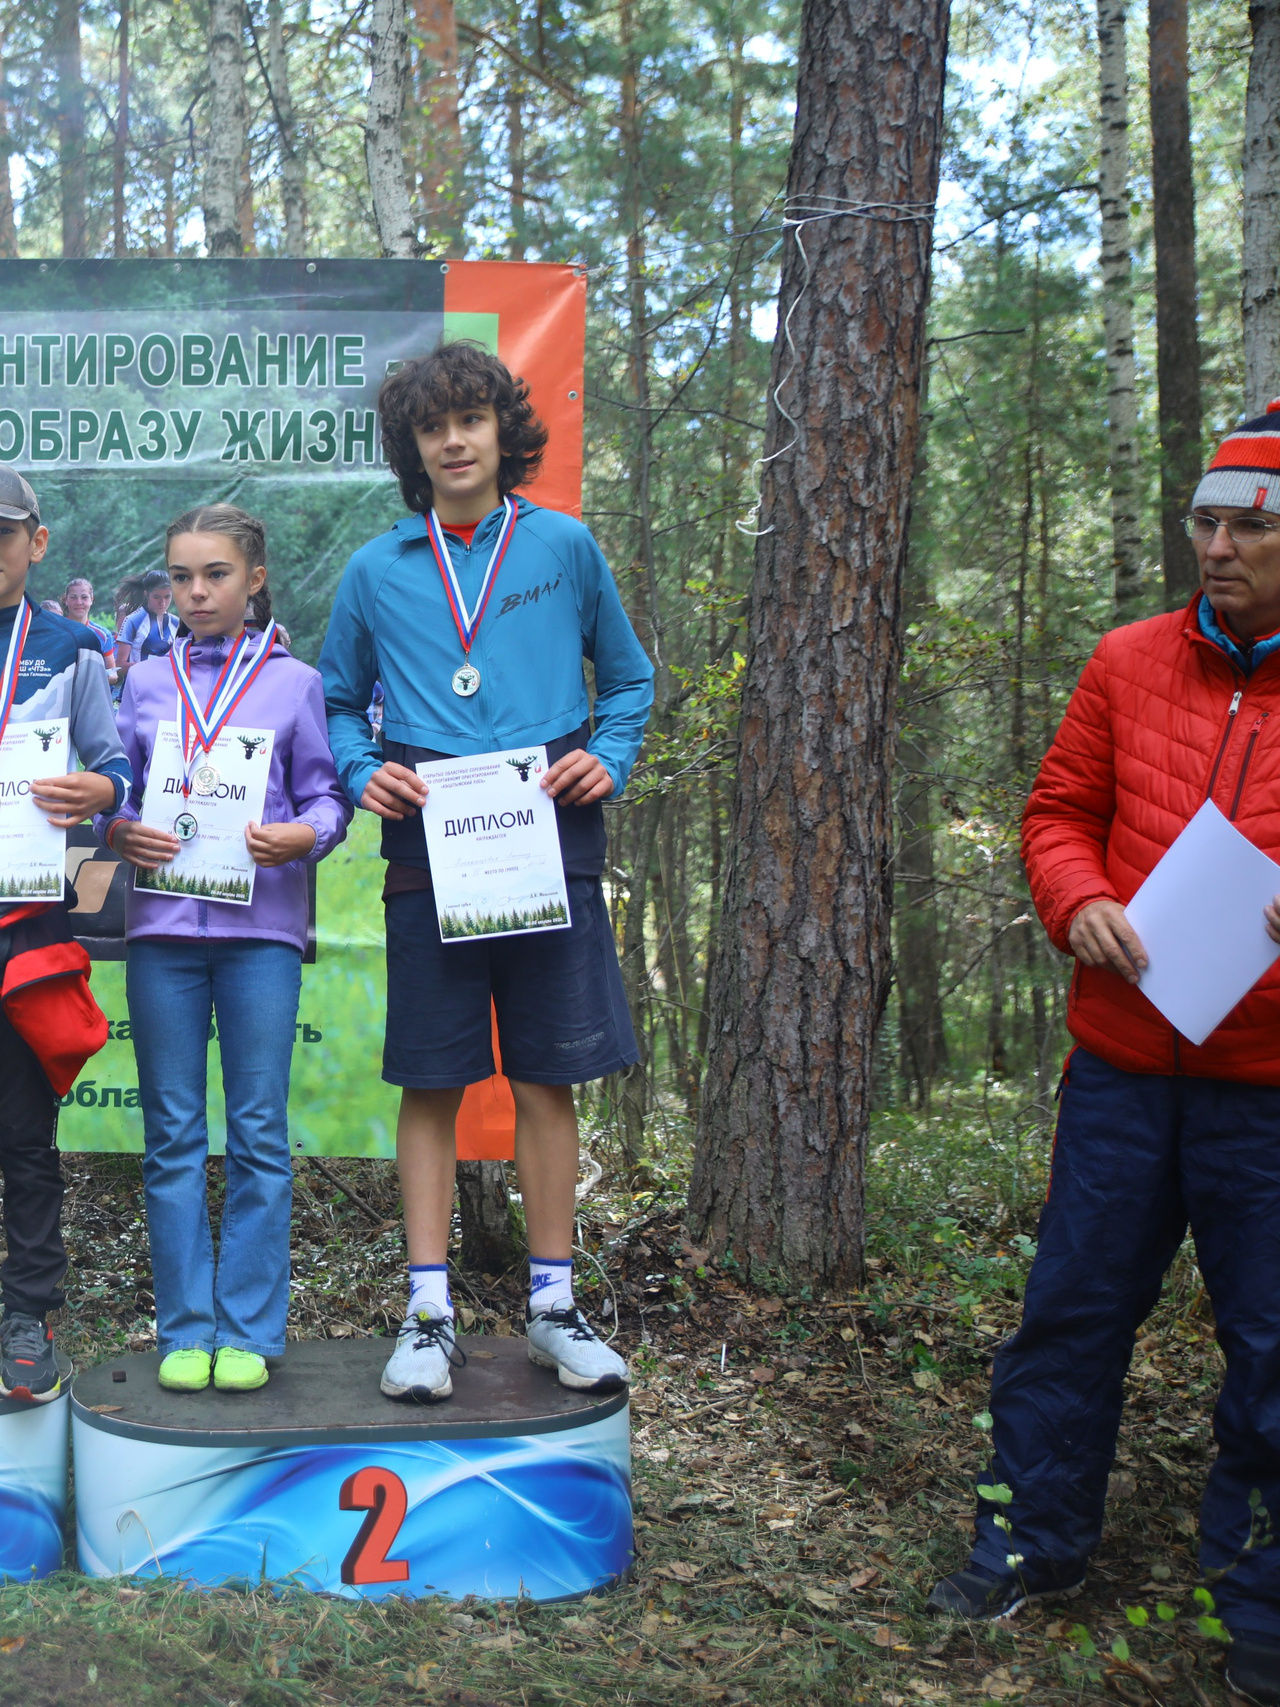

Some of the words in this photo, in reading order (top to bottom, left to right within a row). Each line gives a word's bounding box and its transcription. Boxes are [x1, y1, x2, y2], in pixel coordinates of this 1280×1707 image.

[220, 408, 390, 464] ЖИЗН
[444, 808, 535, 838] ДИПЛОМ
[338, 1465, 410, 1586] 2
